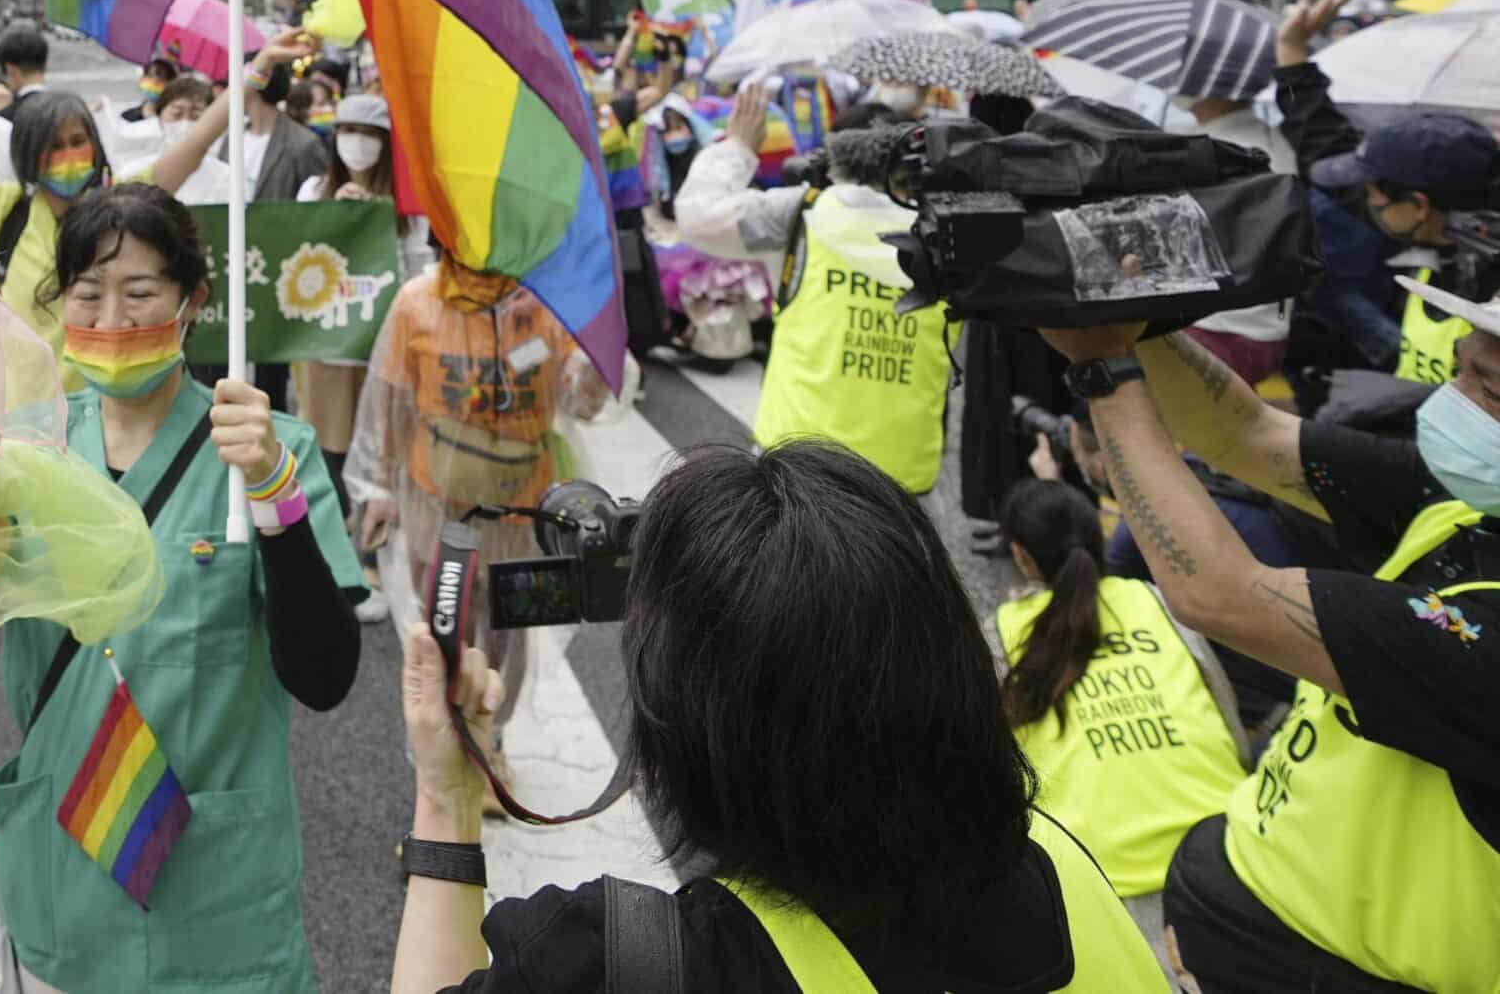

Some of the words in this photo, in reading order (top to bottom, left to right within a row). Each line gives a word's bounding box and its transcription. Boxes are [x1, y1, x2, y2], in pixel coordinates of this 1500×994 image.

[827, 269, 908, 300] PRE
[847, 305, 918, 339] TOKYO
[843, 330, 917, 356] RAINBOW
[840, 349, 914, 385] PRIDE
[432, 560, 463, 636] Canon
[1074, 693, 1166, 721] RAINBOW
[1084, 714, 1185, 761] PRIDE
